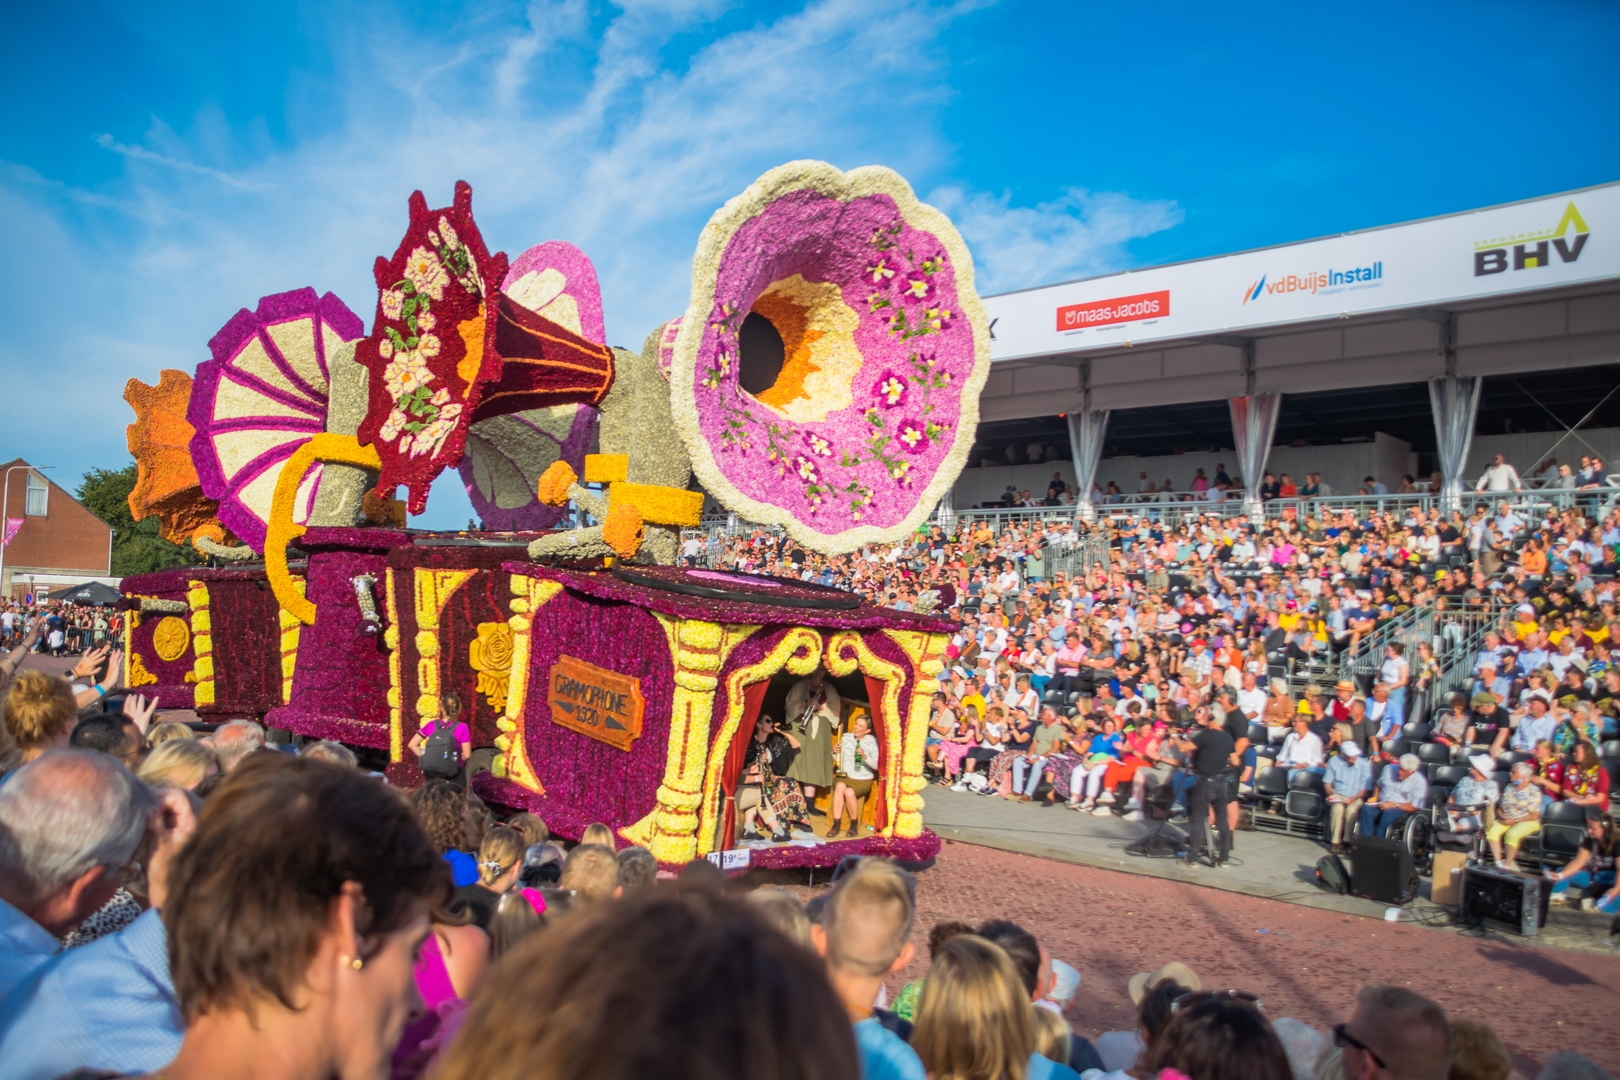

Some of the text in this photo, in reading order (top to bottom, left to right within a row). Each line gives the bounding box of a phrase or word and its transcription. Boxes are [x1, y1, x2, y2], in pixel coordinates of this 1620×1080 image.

[1474, 232, 1590, 277] BHV
[554, 674, 628, 716] GRAMOPHONE
[575, 704, 599, 726] 1920
